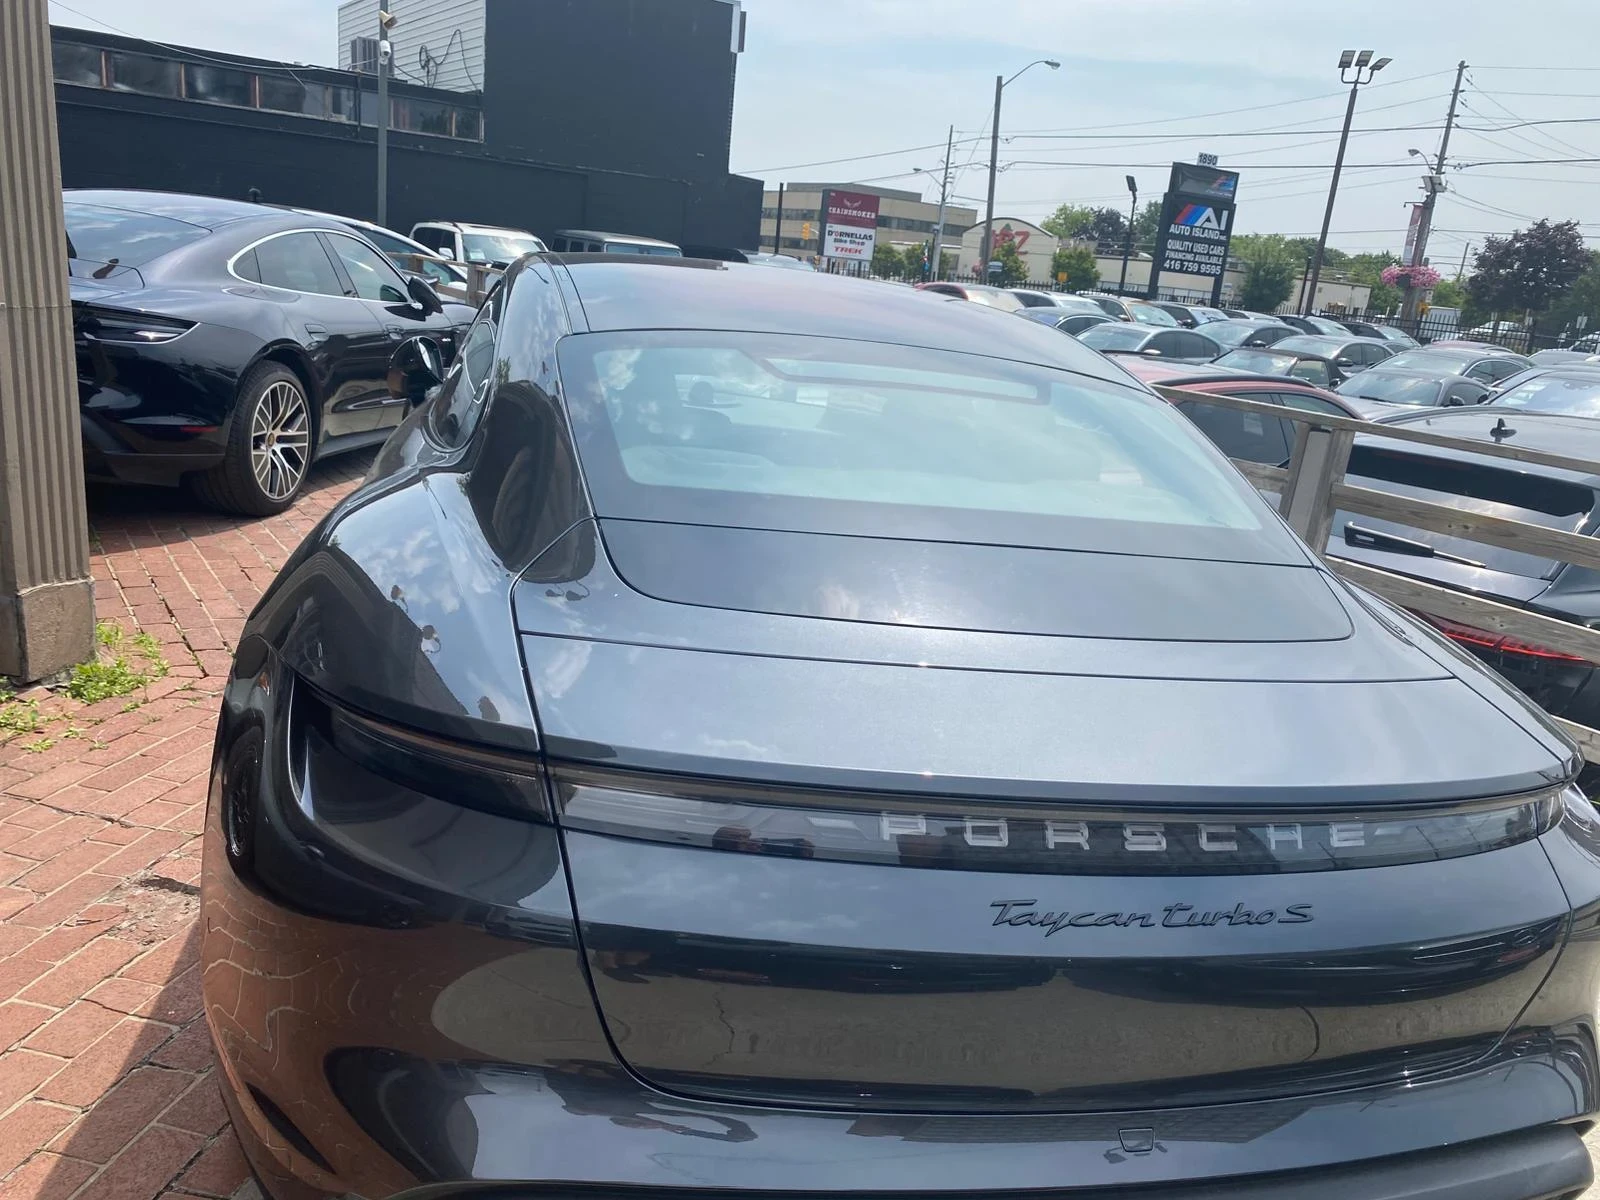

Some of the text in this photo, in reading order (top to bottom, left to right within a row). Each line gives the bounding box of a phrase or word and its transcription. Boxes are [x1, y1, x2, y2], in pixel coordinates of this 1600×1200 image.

[1199, 153, 1218, 166] 1890
[827, 230, 873, 241] D'ORNELLAS
[1169, 224, 1190, 236] AUTO
[1192, 227, 1220, 240] ISLAND
[834, 246, 863, 254] TREK
[1167, 239, 1225, 256] QUALITY USED CARS
[1165, 250, 1223, 265] FINANCING AVAILABLE
[1164, 259, 1222, 275] 416 759 9595
[879, 811, 1365, 853] PORSCHE
[990, 898, 1315, 938] Taycan turbo S
